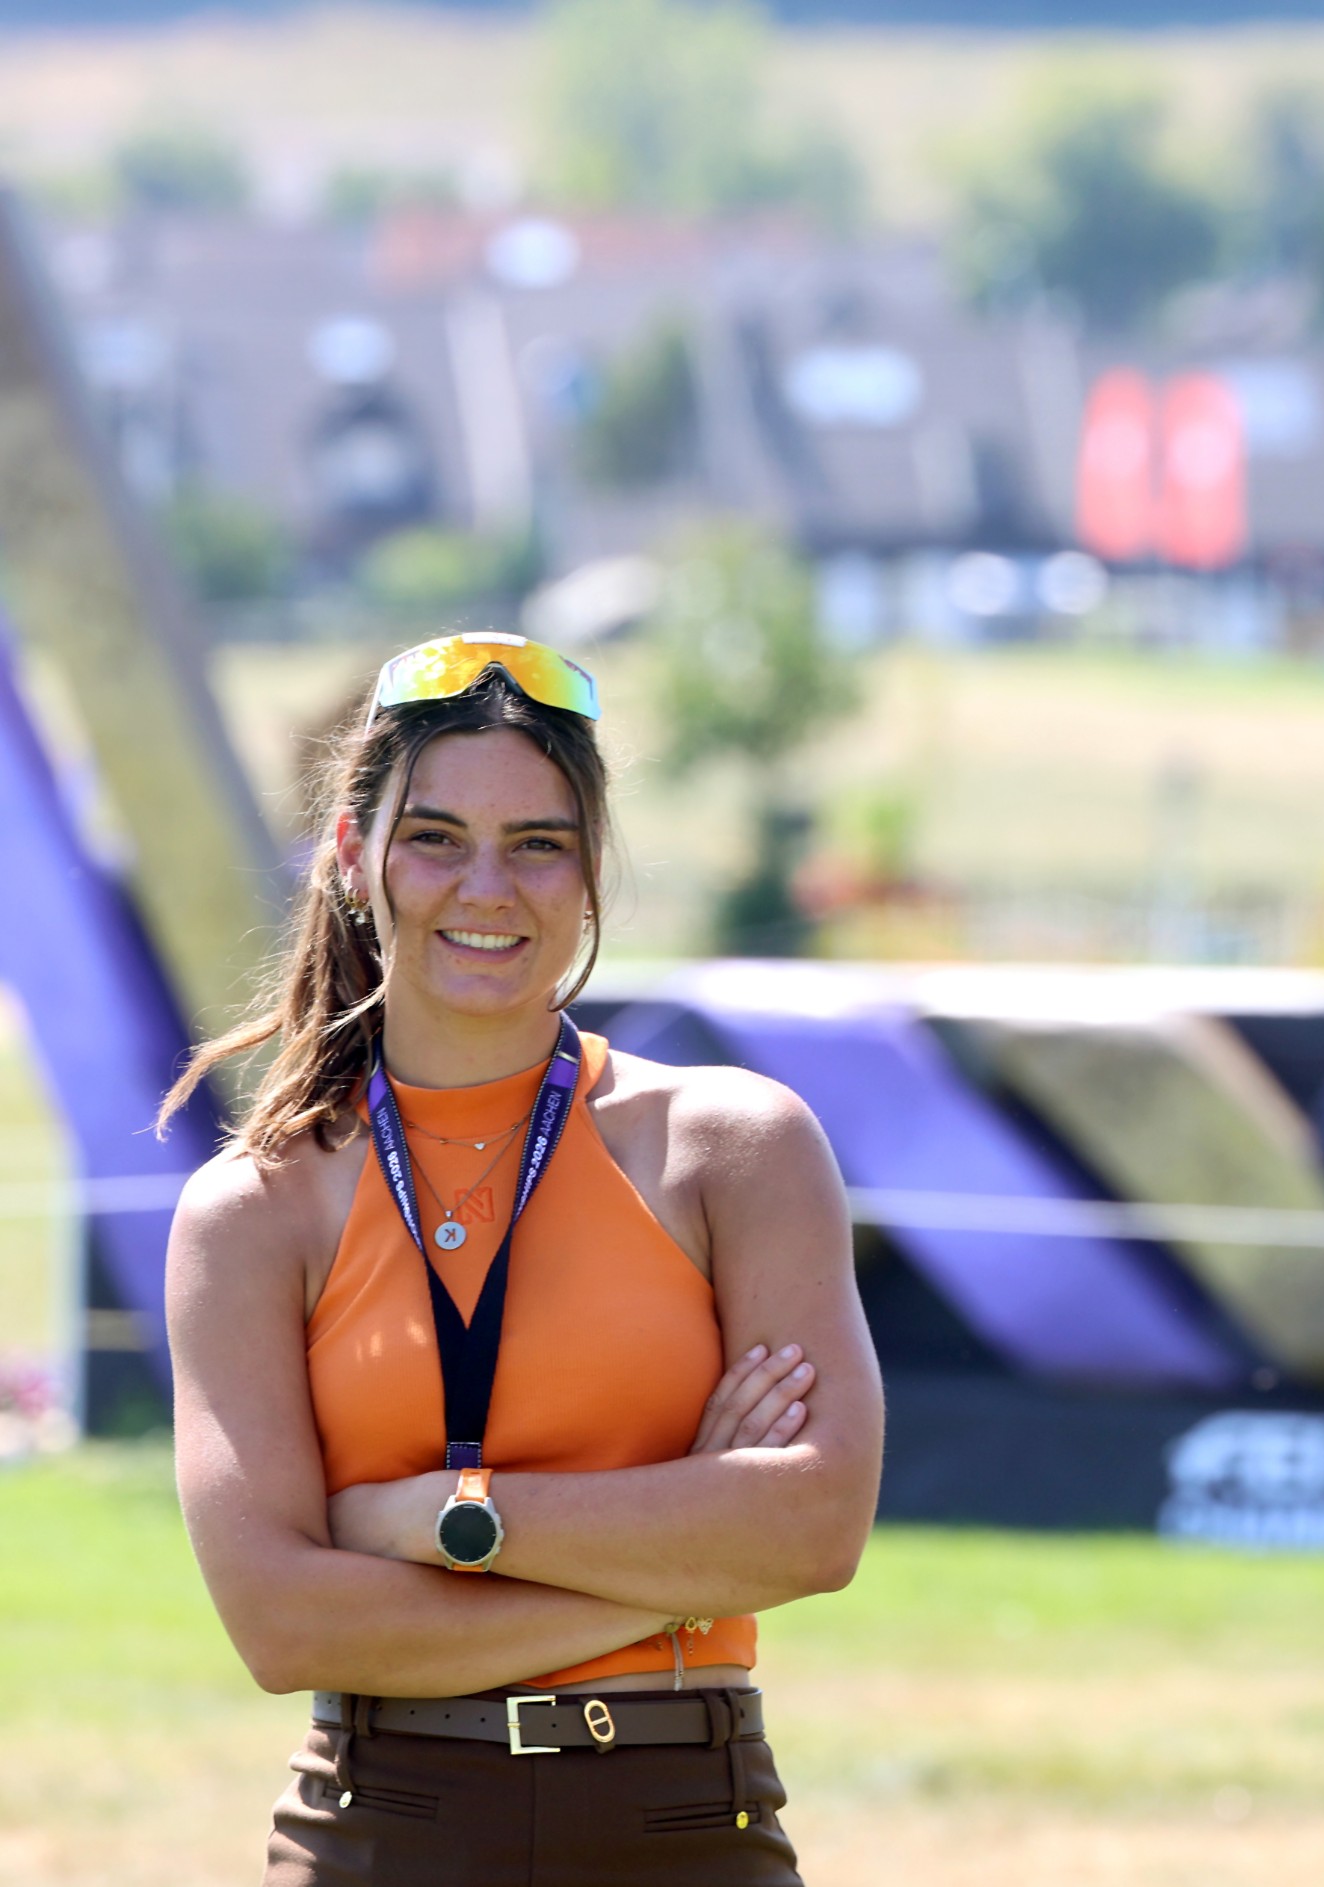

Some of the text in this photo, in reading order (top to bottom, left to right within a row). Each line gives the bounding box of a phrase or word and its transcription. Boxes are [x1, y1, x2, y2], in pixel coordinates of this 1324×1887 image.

[376, 1107, 396, 1151] AACHEN
[531, 1090, 562, 1169] 2026 AACHEN
[387, 1151, 403, 1182] 2026
